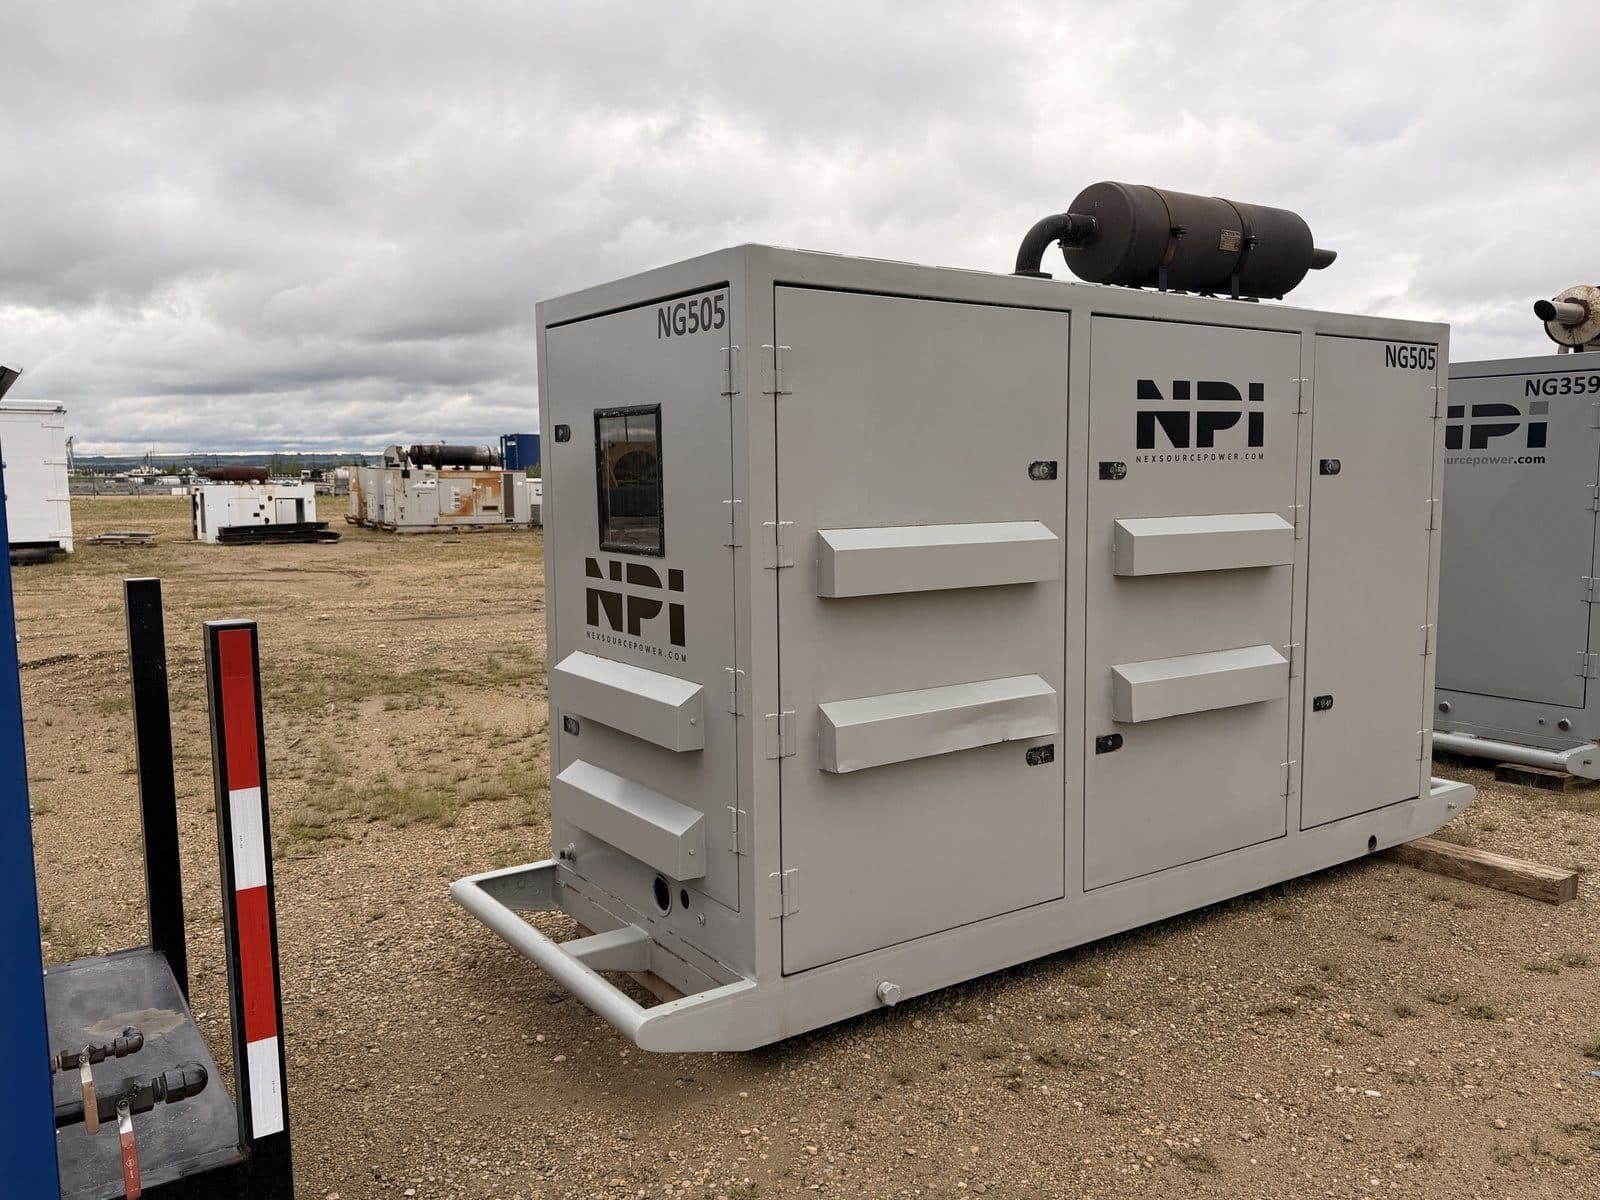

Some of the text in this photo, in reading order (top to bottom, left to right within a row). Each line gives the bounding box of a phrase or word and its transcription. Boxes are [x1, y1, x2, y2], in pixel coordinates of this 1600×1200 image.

[658, 294, 725, 339] NG505
[1385, 344, 1436, 370] NG505
[1524, 375, 1600, 396] NG359
[1136, 452, 1264, 463] NEXSOURCEPOWER.COM
[1444, 455, 1546, 466] urcepower.com
[586, 631, 687, 662] NEXSOURCEPOWER.COM
